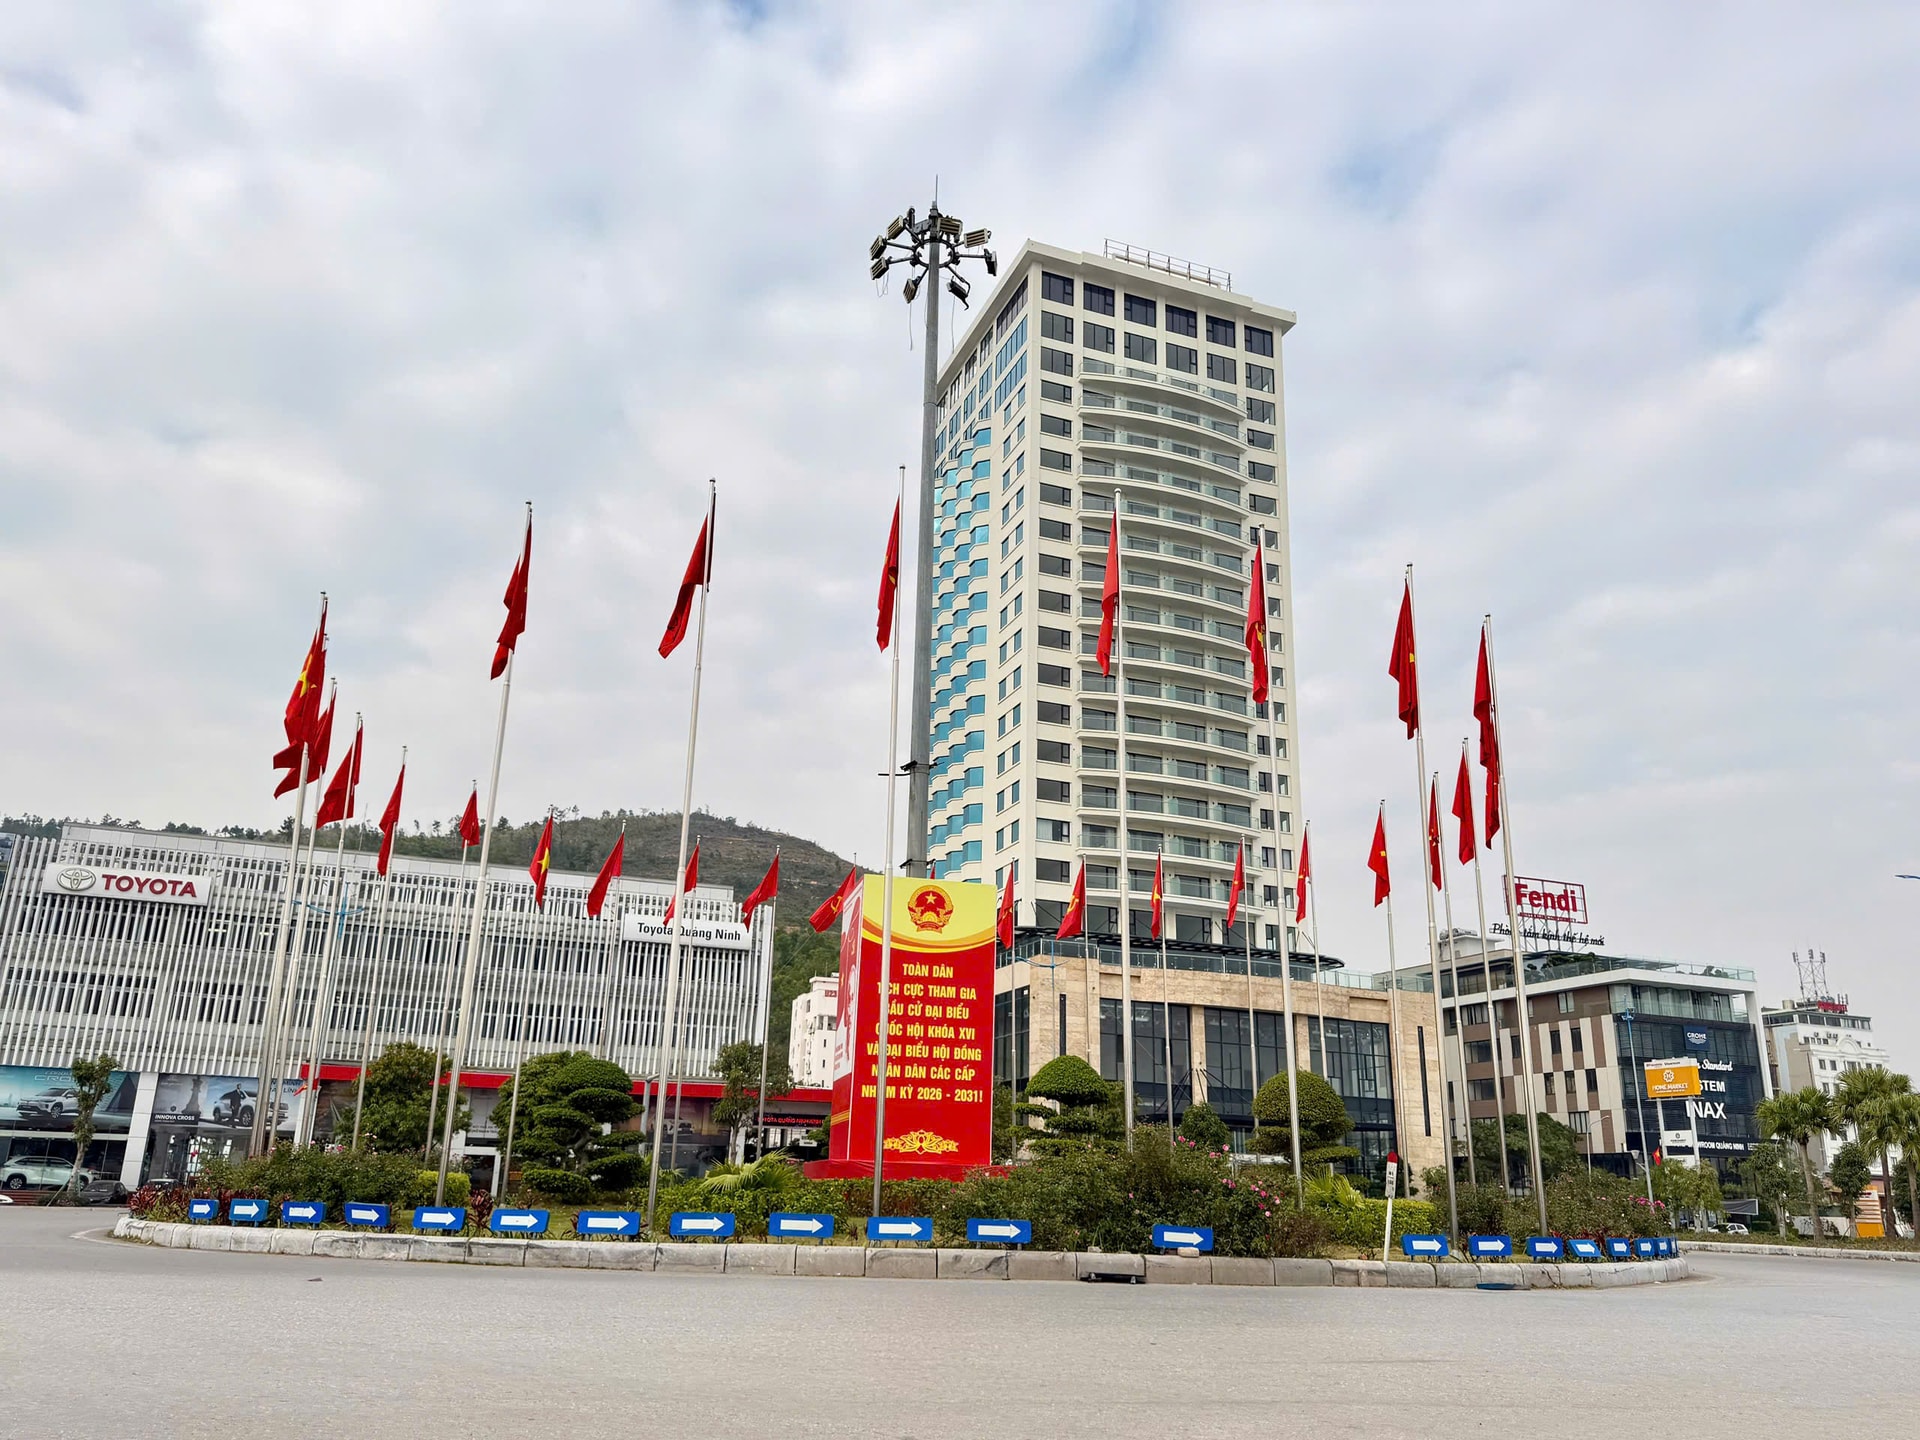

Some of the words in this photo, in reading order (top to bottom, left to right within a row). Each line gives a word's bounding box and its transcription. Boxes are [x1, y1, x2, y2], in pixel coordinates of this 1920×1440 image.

[102, 874, 197, 898] TOYOTA
[1514, 883, 1578, 912] Fendi
[638, 922, 673, 936] Toyota
[680, 926, 712, 940] Quảng
[715, 929, 741, 941] Ninh
[902, 962, 929, 976] TOÀN
[933, 964, 954, 978] DÂN
[877, 982, 900, 995] TCH
[903, 983, 924, 998] CỰC
[928, 985, 956, 998] THAM
[960, 987, 977, 1000] GIA
[907, 1000, 922, 1016] CỬ
[925, 1004, 942, 1020] ĐẠI
[946, 1003, 969, 1019] BIỂU
[907, 1022, 924, 1039] HỘI
[928, 1024, 955, 1039] KHÓA
[959, 1027, 976, 1040] XVI
[867, 1041, 879, 1056] VÀ
[905, 1041, 929, 1057] BIỂU
[933, 1044, 950, 1061] HỘI
[871, 1063, 900, 1078] NÂN
[905, 1063, 926, 1078] DÂN
[930, 1065, 951, 1080] CÁC
[955, 1064, 975, 1081] CẤP
[1701, 1059, 1733, 1071] Standard
[861, 1085, 896, 1098] NHM
[900, 1084, 913, 1099] KỲ
[917, 1087, 942, 1100] 2026
[954, 1089, 983, 1102] 2031!
[1699, 1080, 1726, 1092] STEM
[155, 1114, 177, 1122] INNOVA
[1686, 1101, 1727, 1119] INAX
